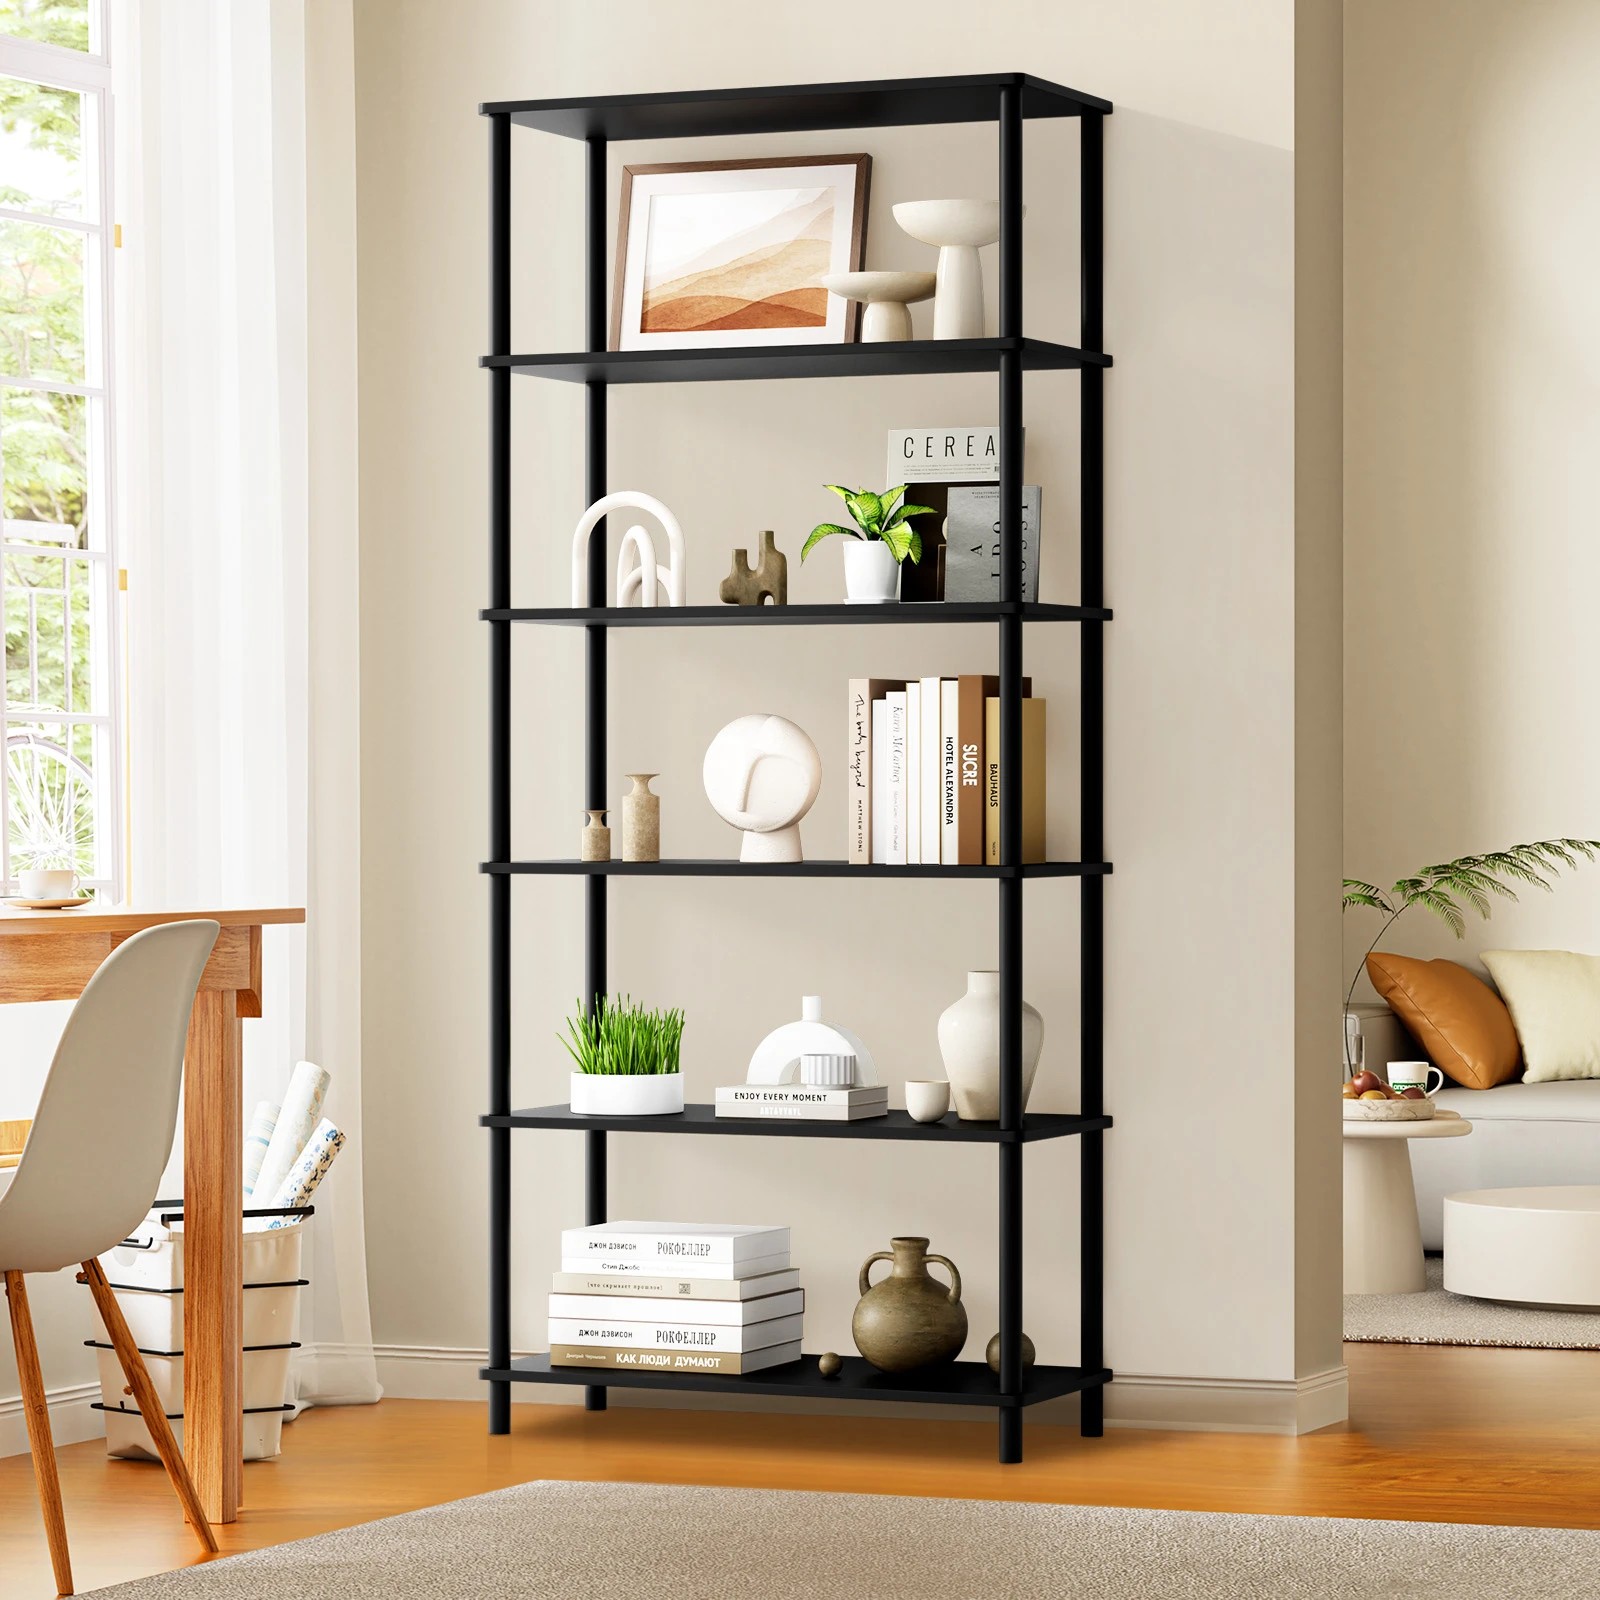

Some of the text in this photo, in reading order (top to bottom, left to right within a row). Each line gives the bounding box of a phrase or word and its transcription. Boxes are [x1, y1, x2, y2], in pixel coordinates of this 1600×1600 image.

[962, 744, 978, 786] SUCRE
[945, 736, 954, 825] HOTEL ALEXANDRA
[989, 763, 998, 808] BAUHAUS
[734, 1092, 828, 1102] ENJOY EVERY MOMENT
[588, 1241, 607, 1250] ДЖОН
[657, 1241, 711, 1257] РОКФЕЛЛЕР
[601, 1263, 618, 1271] Стив
[618, 1264, 641, 1272] Джобс
[578, 1328, 717, 1346] ДЖОН ДЭВИСОН РОКФЕЛЛЕР
[616, 1352, 637, 1364] КАК
[638, 1354, 671, 1367] ЛЮДИ
[674, 1355, 721, 1368] ДУМАЮТ
